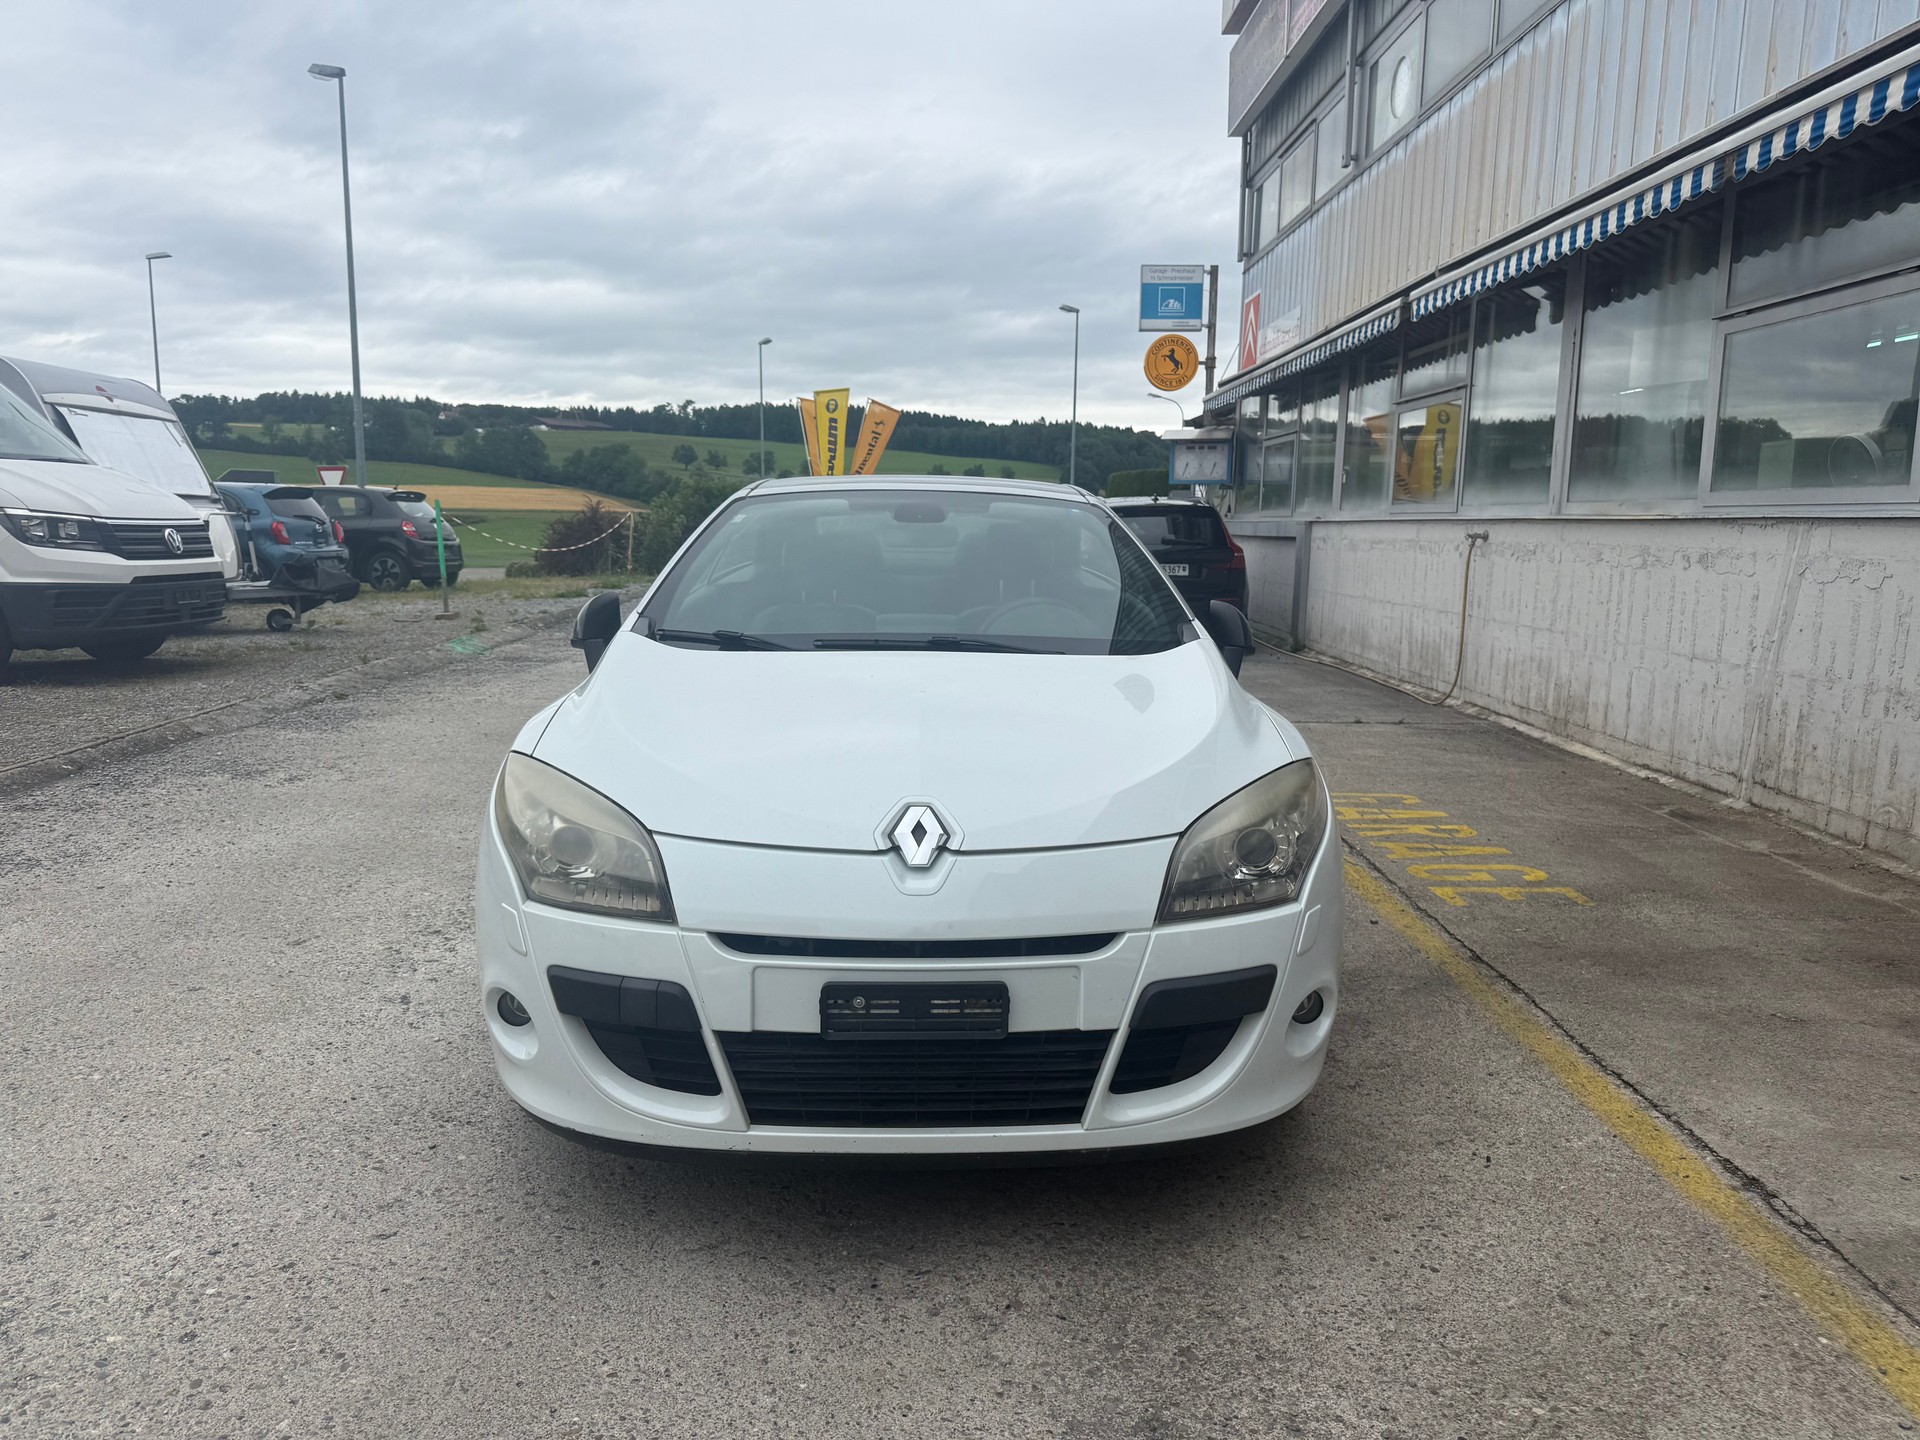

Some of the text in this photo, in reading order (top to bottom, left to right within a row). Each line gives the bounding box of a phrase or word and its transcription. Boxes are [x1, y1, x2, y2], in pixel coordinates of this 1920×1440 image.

[1151, 338, 1193, 356] CONTINENTAL
[1154, 374, 1189, 386] SINCE 1871
[1331, 793, 1597, 906] GARAGE
